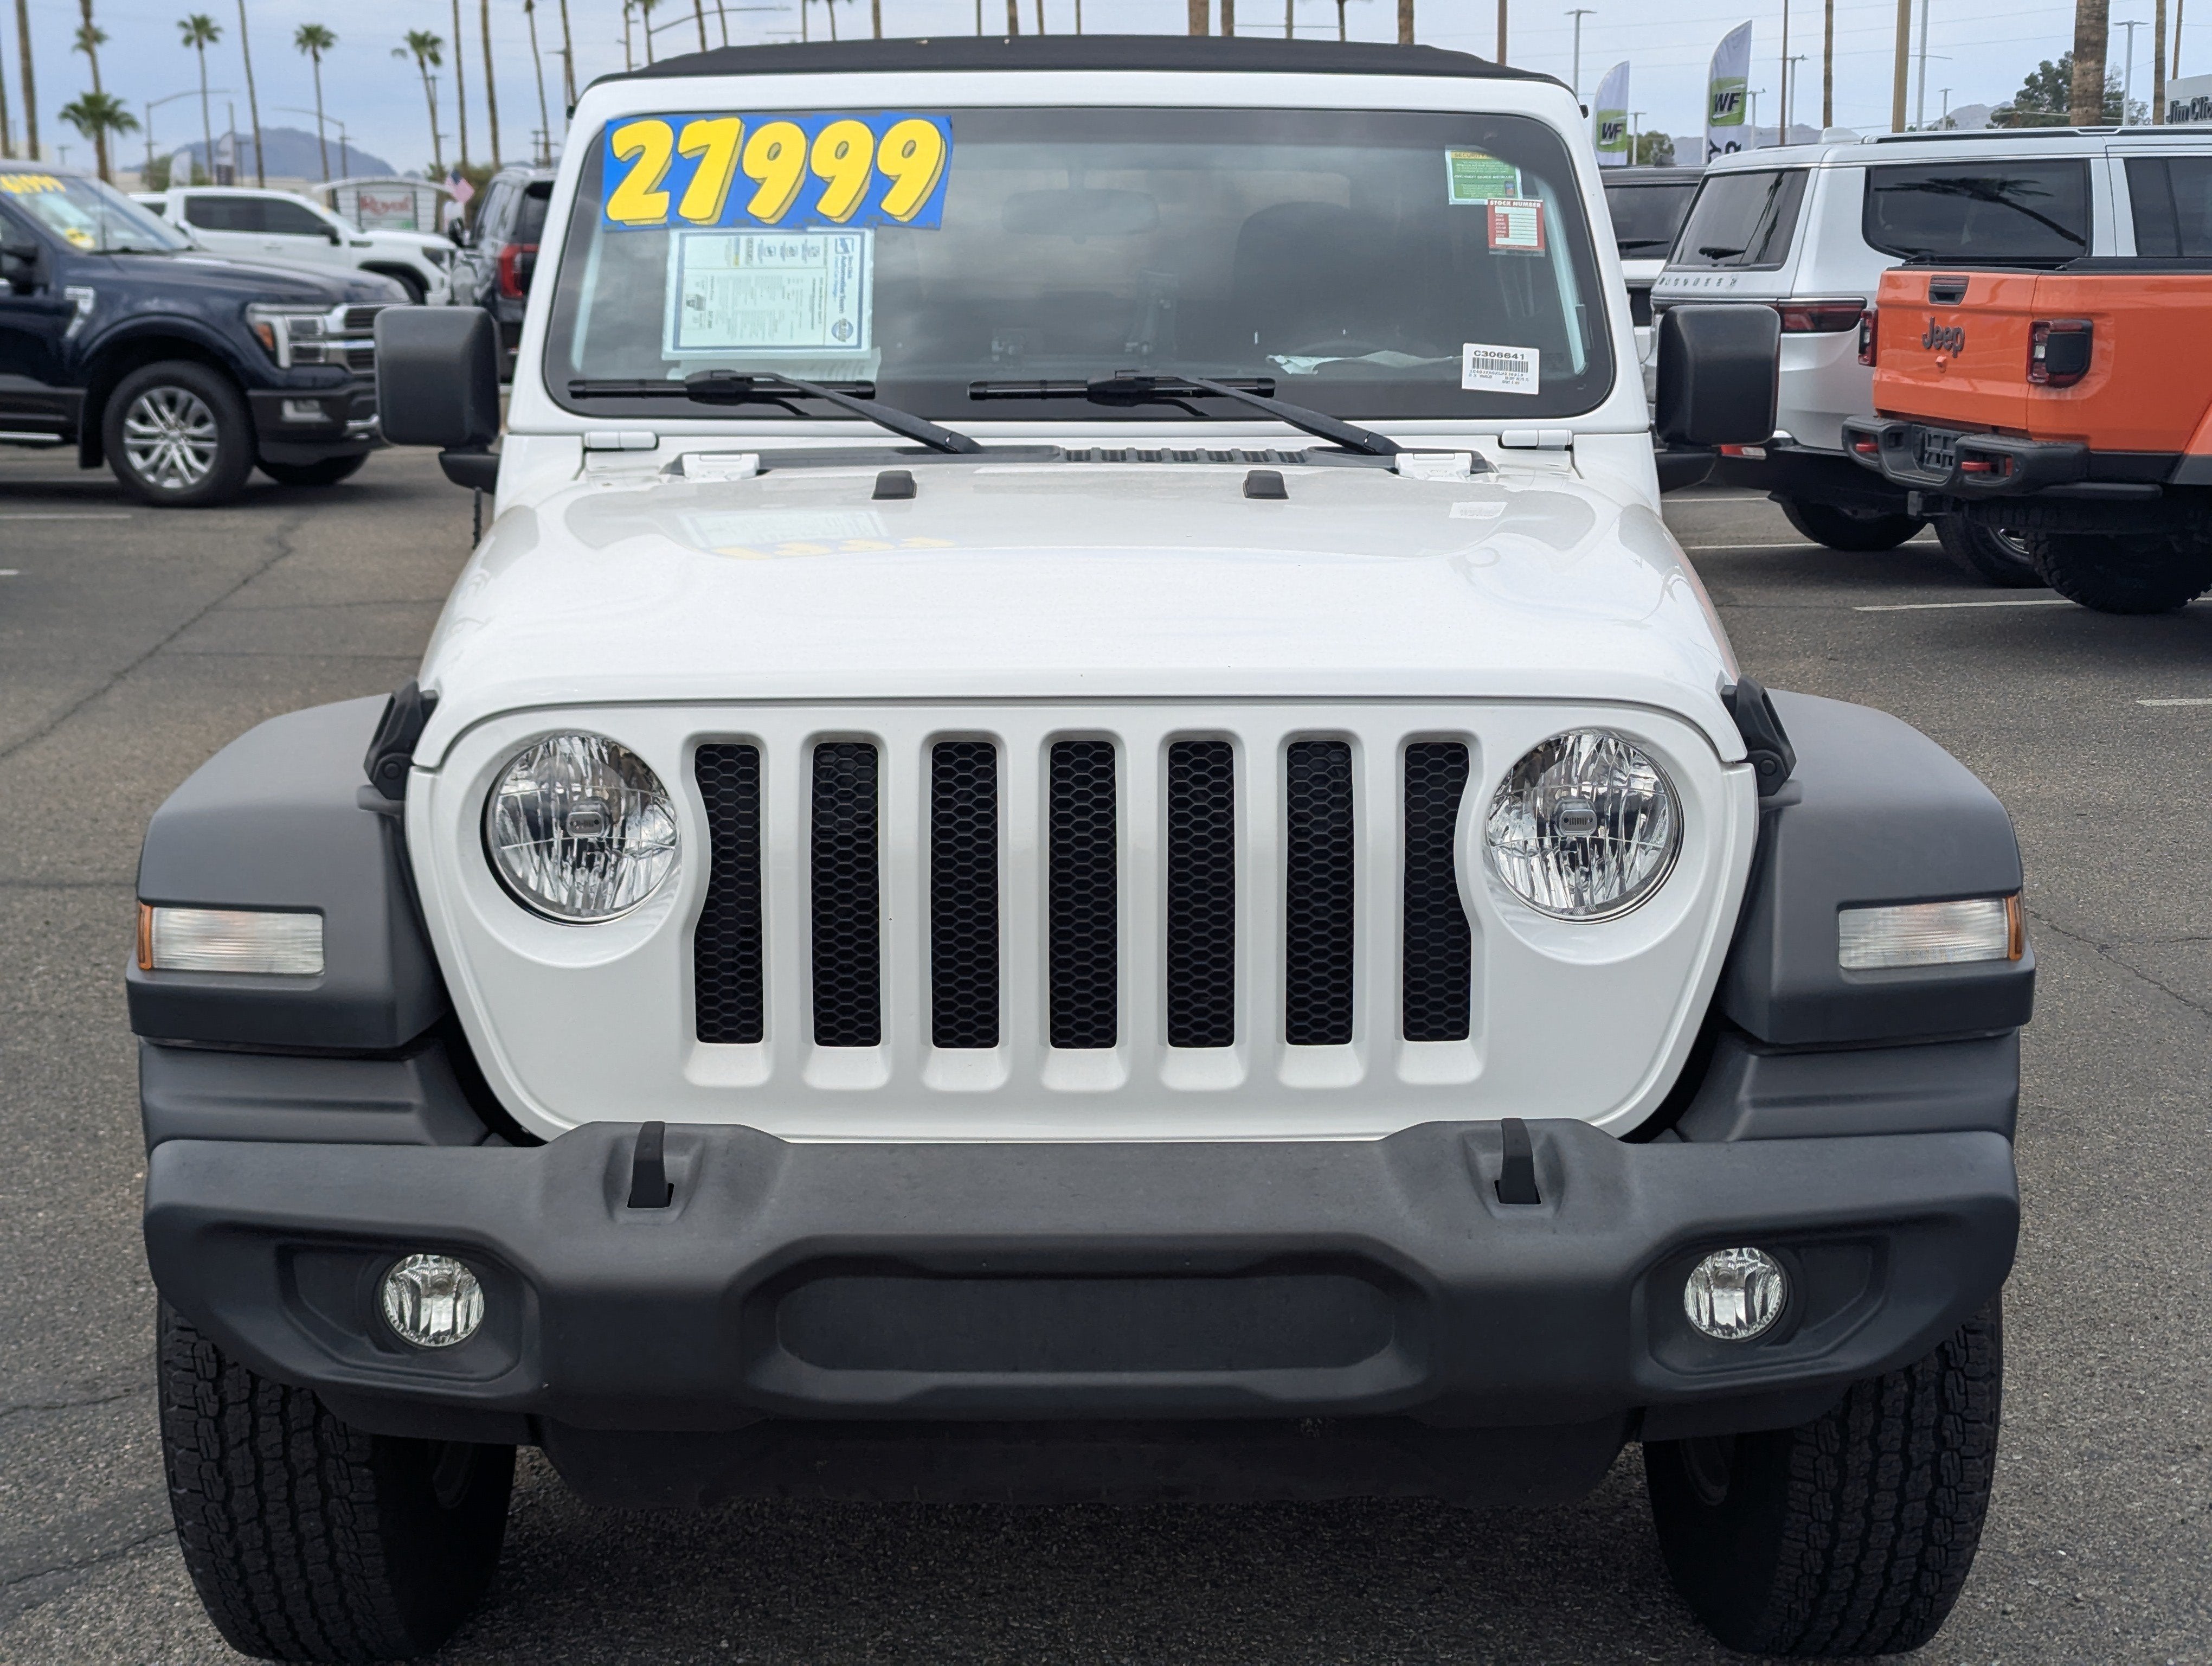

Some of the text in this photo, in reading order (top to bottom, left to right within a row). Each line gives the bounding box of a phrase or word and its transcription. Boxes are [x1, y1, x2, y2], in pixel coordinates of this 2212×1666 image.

[1714, 92, 1741, 112] WF
[2166, 100, 2189, 123] Jim
[1602, 123, 1623, 139] WF
[605, 116, 947, 225] 27999
[1922, 316, 1965, 358] Jeep
[1474, 350, 1525, 360] C306641
